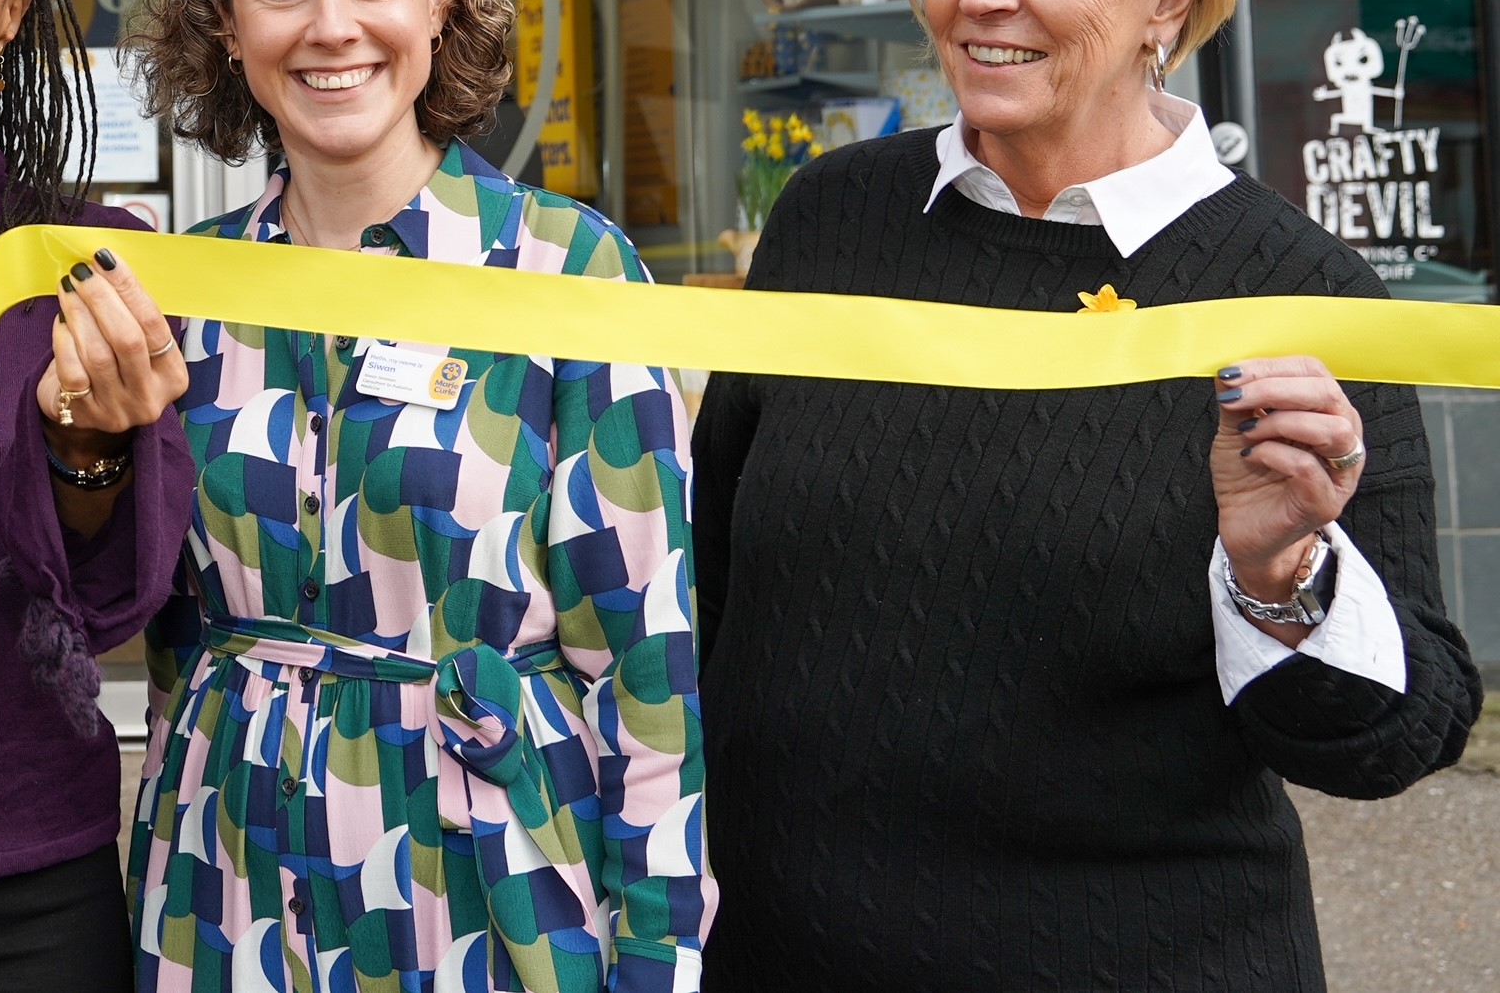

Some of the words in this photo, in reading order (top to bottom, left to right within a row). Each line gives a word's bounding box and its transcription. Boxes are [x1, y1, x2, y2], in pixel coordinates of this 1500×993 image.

[1302, 126, 1441, 184] CRAFTY
[1305, 180, 1445, 240] DEVIL
[368, 361, 396, 372] Siwan
[435, 379, 459, 389] Marie
[434, 387, 456, 396] Curie
